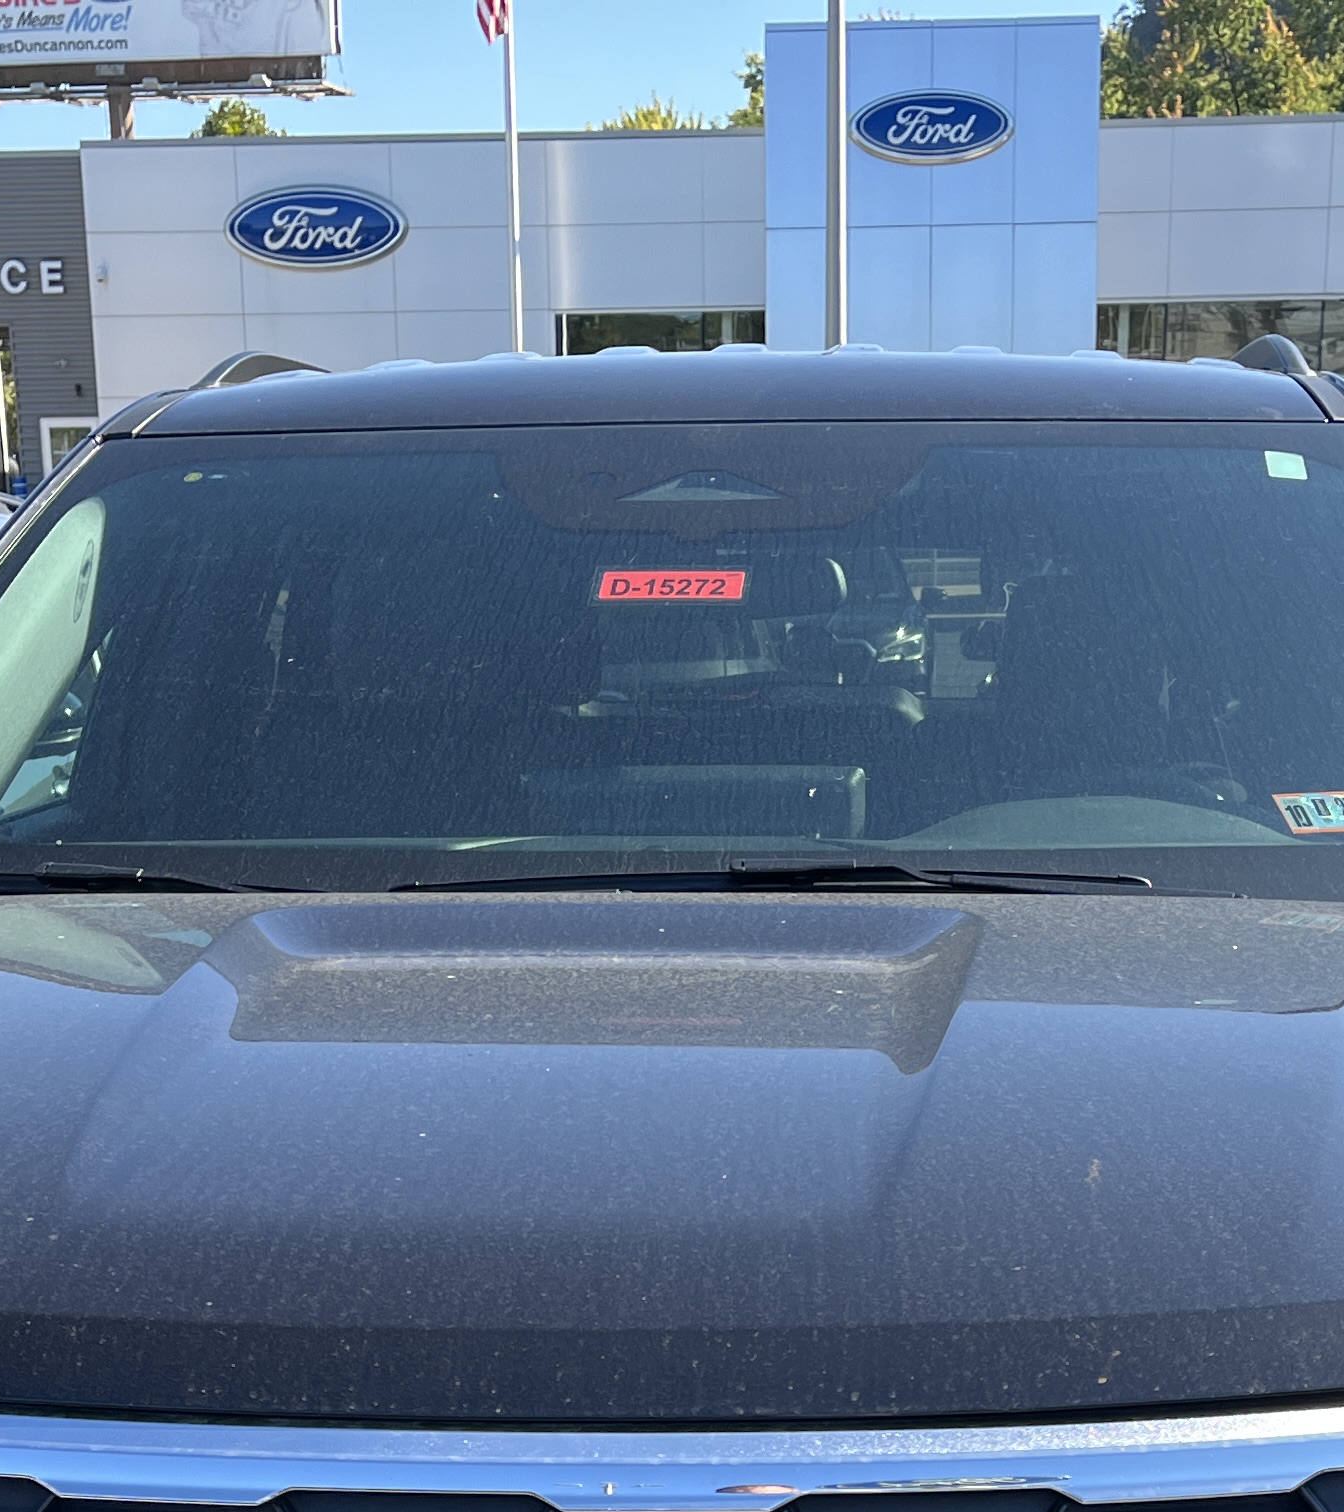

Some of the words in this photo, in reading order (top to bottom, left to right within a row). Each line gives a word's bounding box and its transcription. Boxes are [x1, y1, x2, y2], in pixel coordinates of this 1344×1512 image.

[16, 10, 65, 28] Means
[65, 5, 132, 33] More!
[887, 105, 977, 145] Ford
[263, 205, 363, 250] Ford
[609, 579, 726, 596] D-15272
